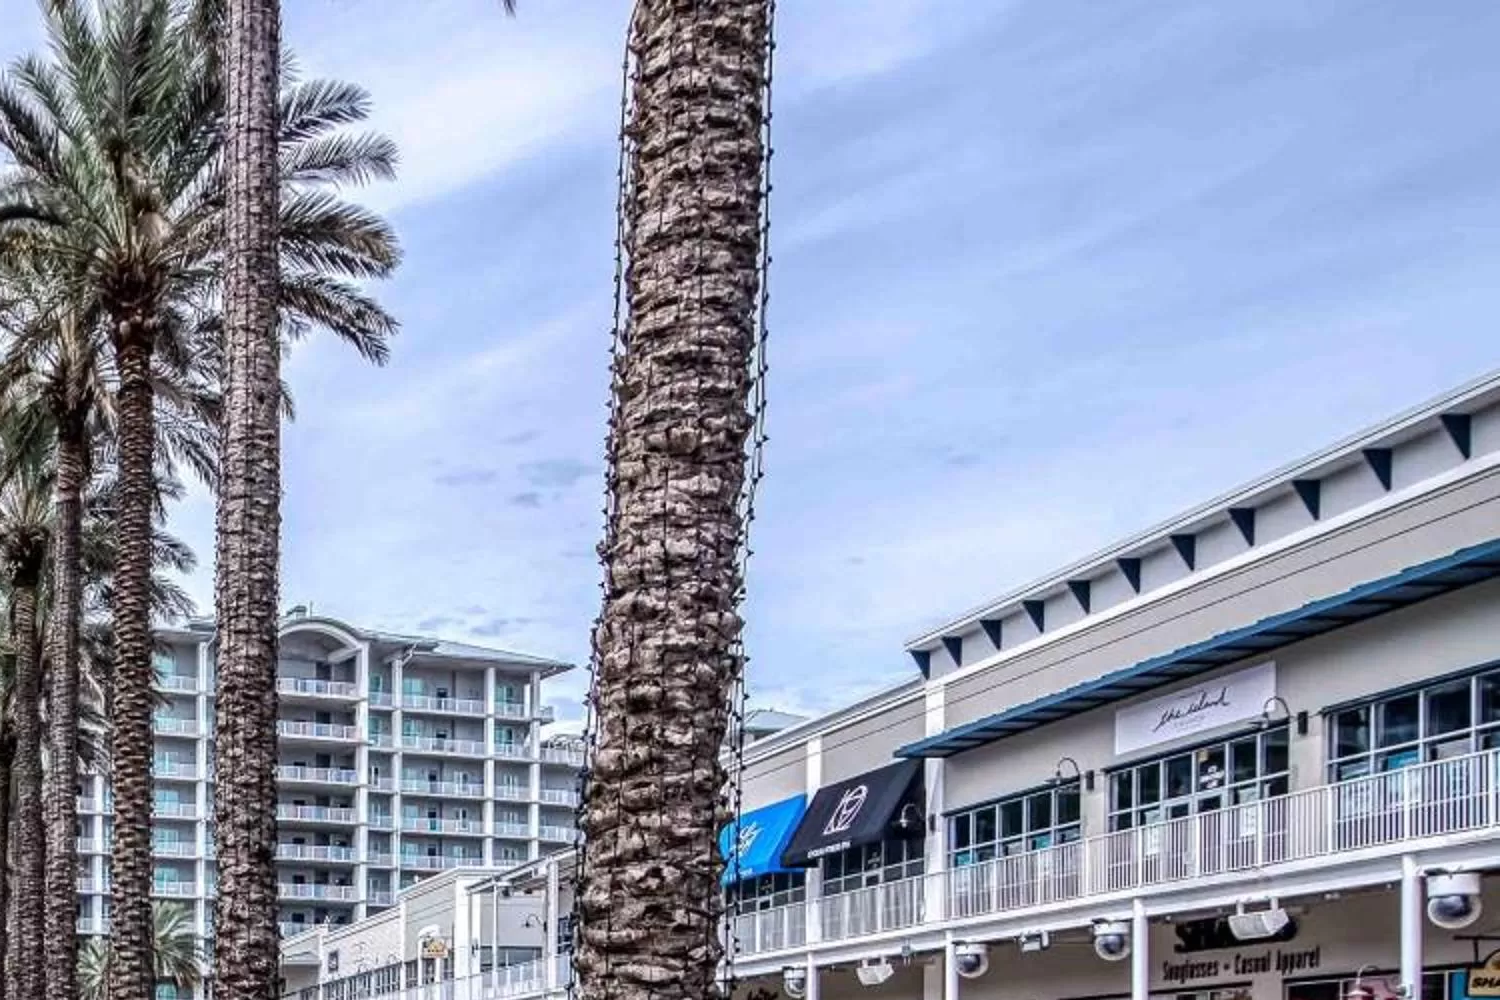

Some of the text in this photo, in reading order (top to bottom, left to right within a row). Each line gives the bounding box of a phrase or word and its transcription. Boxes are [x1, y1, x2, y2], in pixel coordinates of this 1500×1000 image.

[1162, 945, 1321, 984] Sunglasses Casual Apparel
